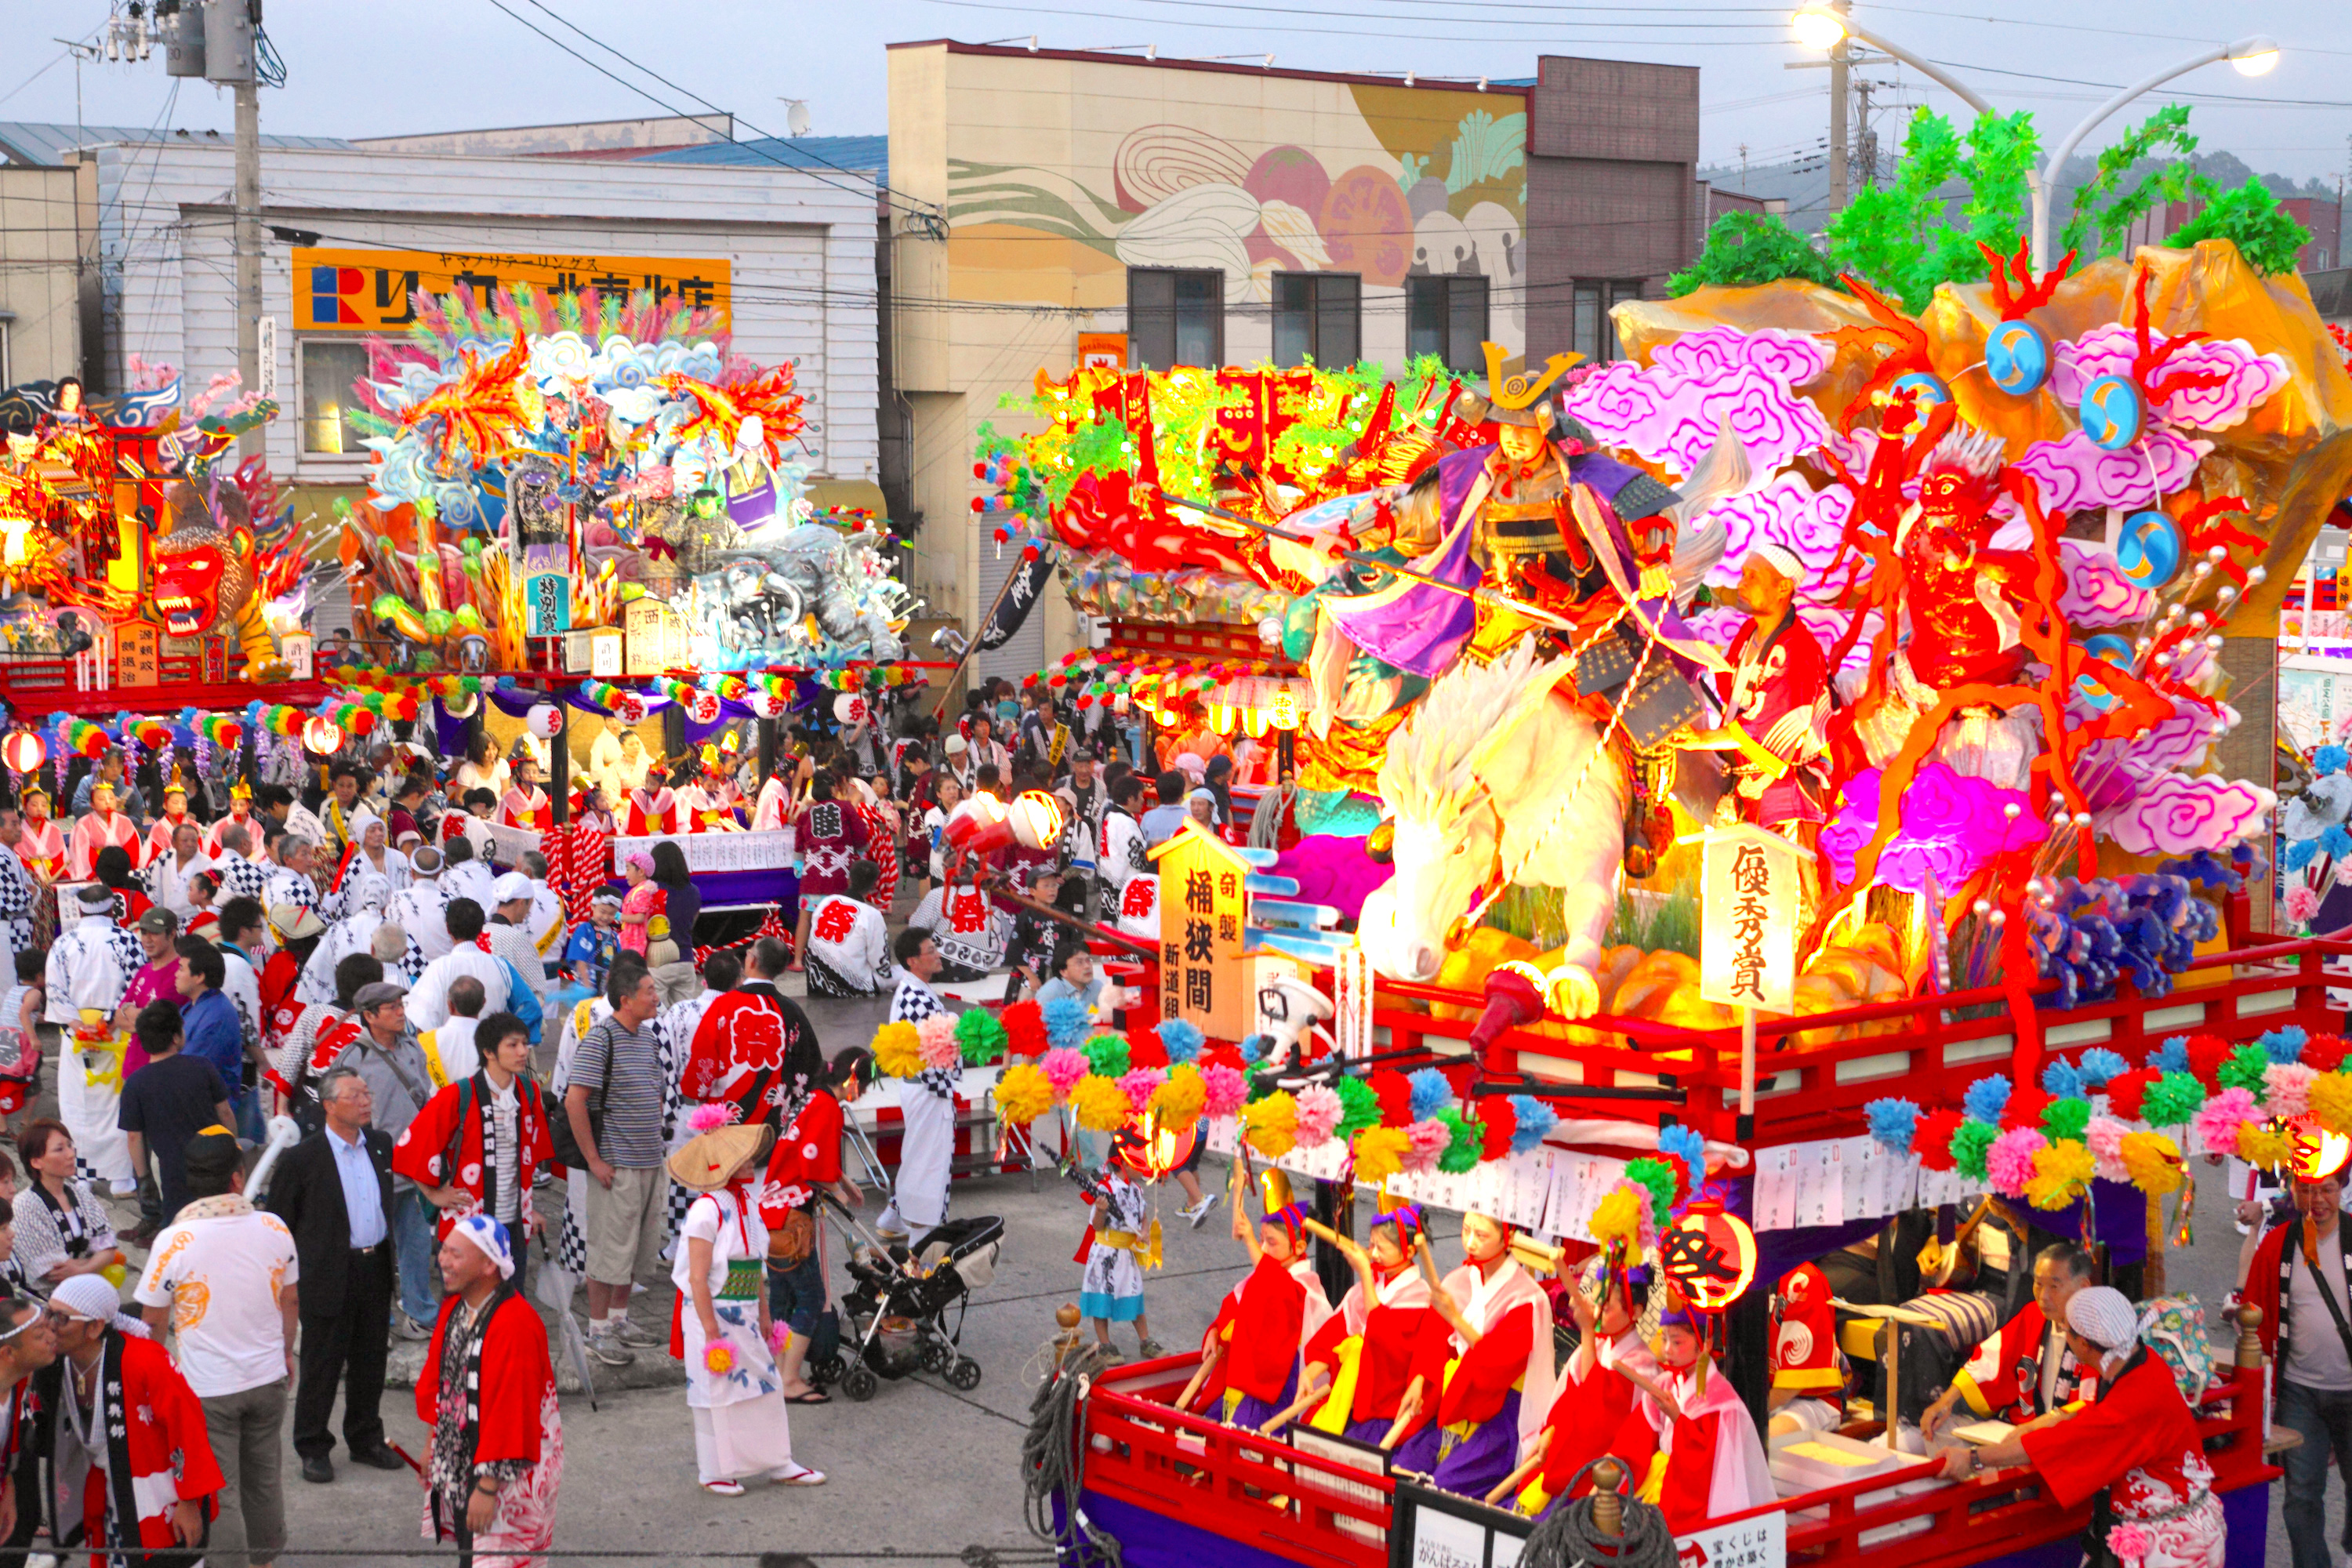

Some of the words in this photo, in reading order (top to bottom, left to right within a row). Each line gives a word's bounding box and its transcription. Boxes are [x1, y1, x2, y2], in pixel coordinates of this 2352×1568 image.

[539, 576, 558, 633] 特別賞
[624, 697, 644, 720] 祭
[697, 695, 717, 718] 祭
[849, 699, 867, 721] 祭
[951, 894, 986, 934] 祭
[1122, 878, 1156, 918] 祭
[1219, 871, 1236, 942] 奇襲
[815, 899, 858, 944] 祭
[1185, 868, 1213, 1014] 桶狭間
[1730, 844, 1770, 1003] 優秀賞
[1164, 942, 1180, 1020] 新道組
[731, 1006, 786, 1072] 祭
[1712, 1528, 1767, 1555] 宝くじは
